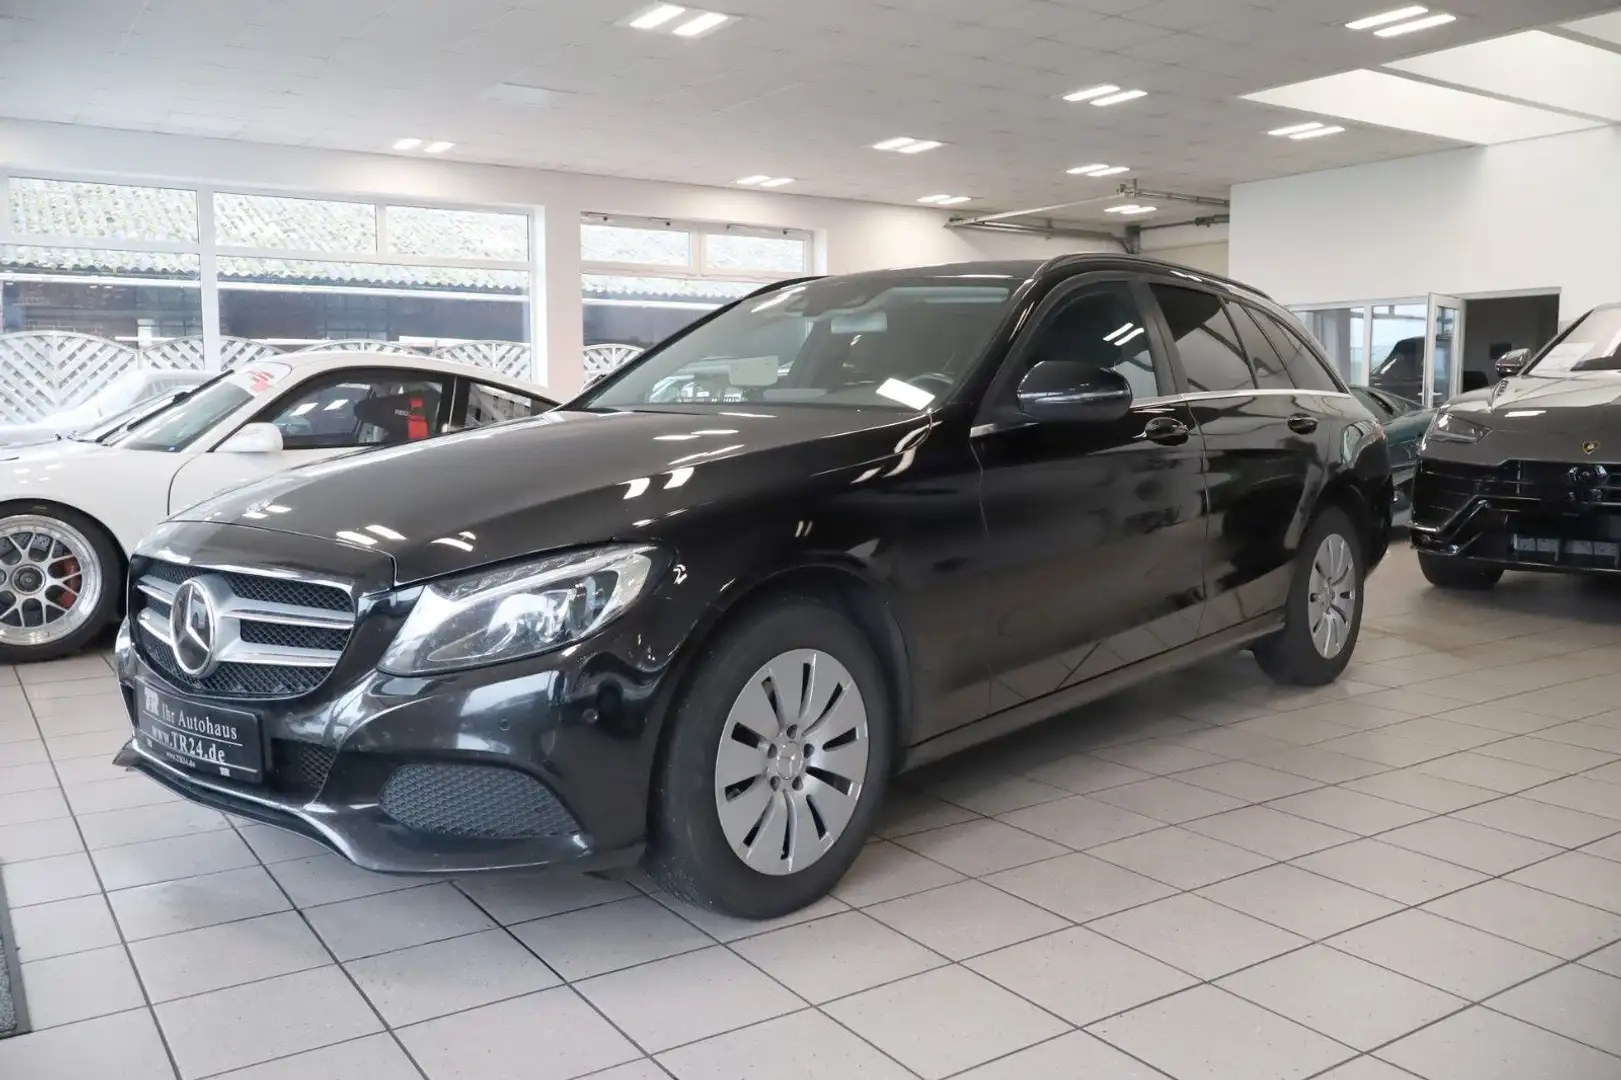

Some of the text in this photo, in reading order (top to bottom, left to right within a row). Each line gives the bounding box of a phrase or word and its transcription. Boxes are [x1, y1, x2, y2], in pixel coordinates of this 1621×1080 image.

[162, 703, 238, 740] Ihr Autohaus
[151, 727, 226, 764] www.TR24.de
